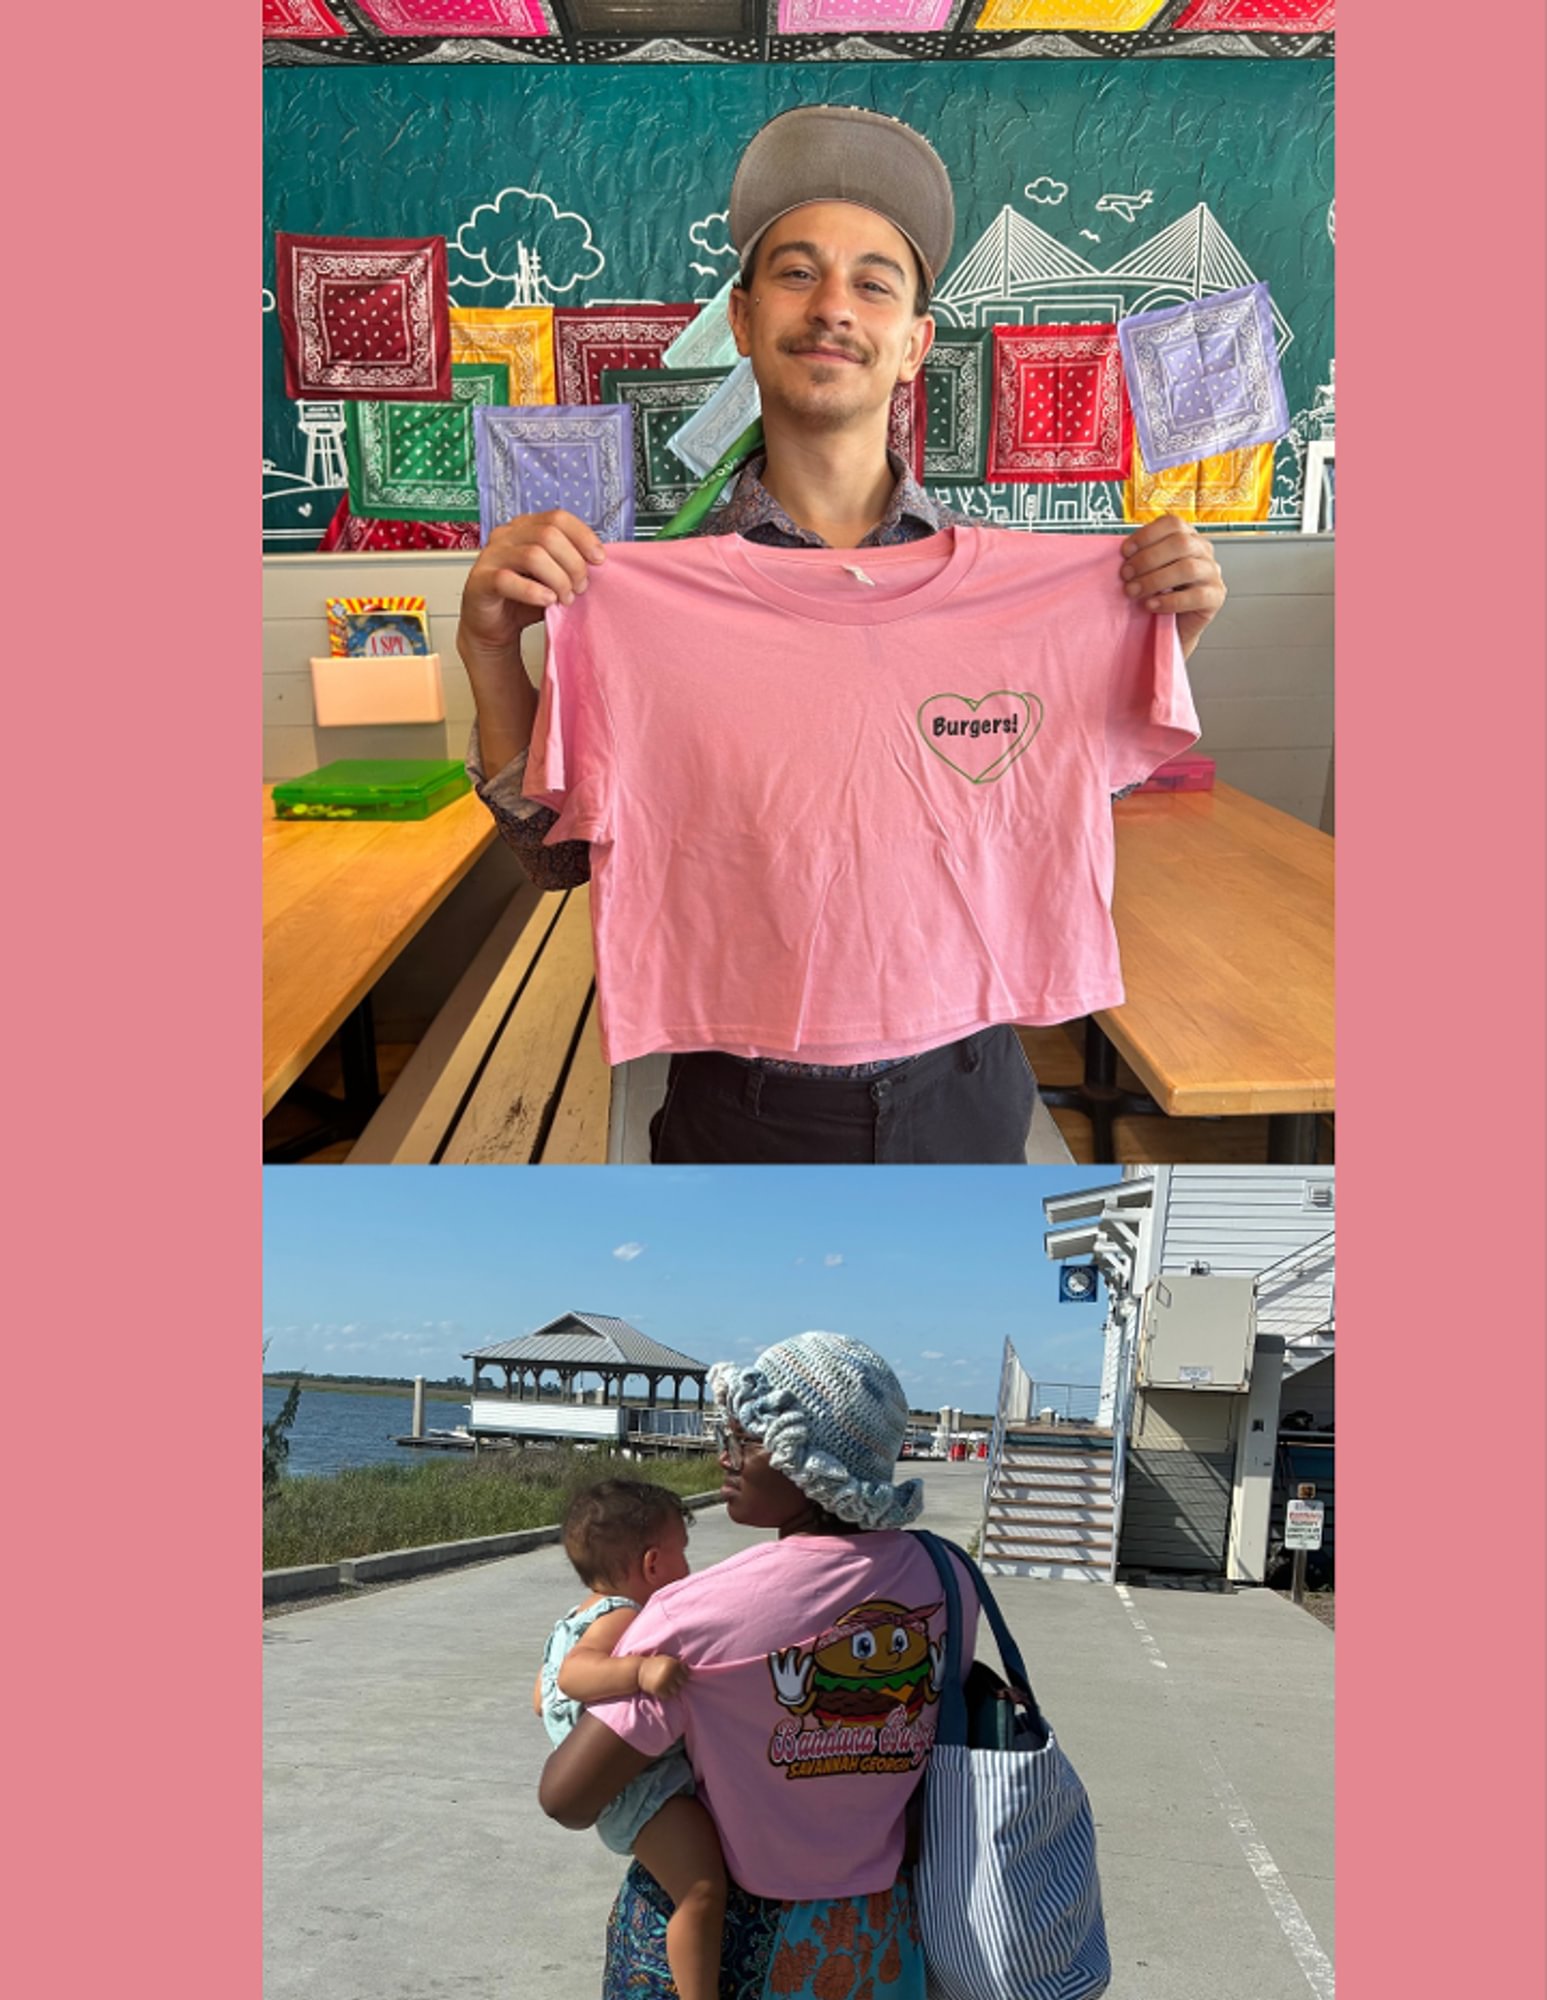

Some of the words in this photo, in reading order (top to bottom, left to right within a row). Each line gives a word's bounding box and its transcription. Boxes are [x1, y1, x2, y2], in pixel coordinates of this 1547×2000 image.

[932, 713, 1018, 738] Burgers!
[771, 1717, 877, 1762] Bandana
[789, 1755, 859, 1777] SAVANNAH
[860, 1756, 910, 1772] GEORGIA
